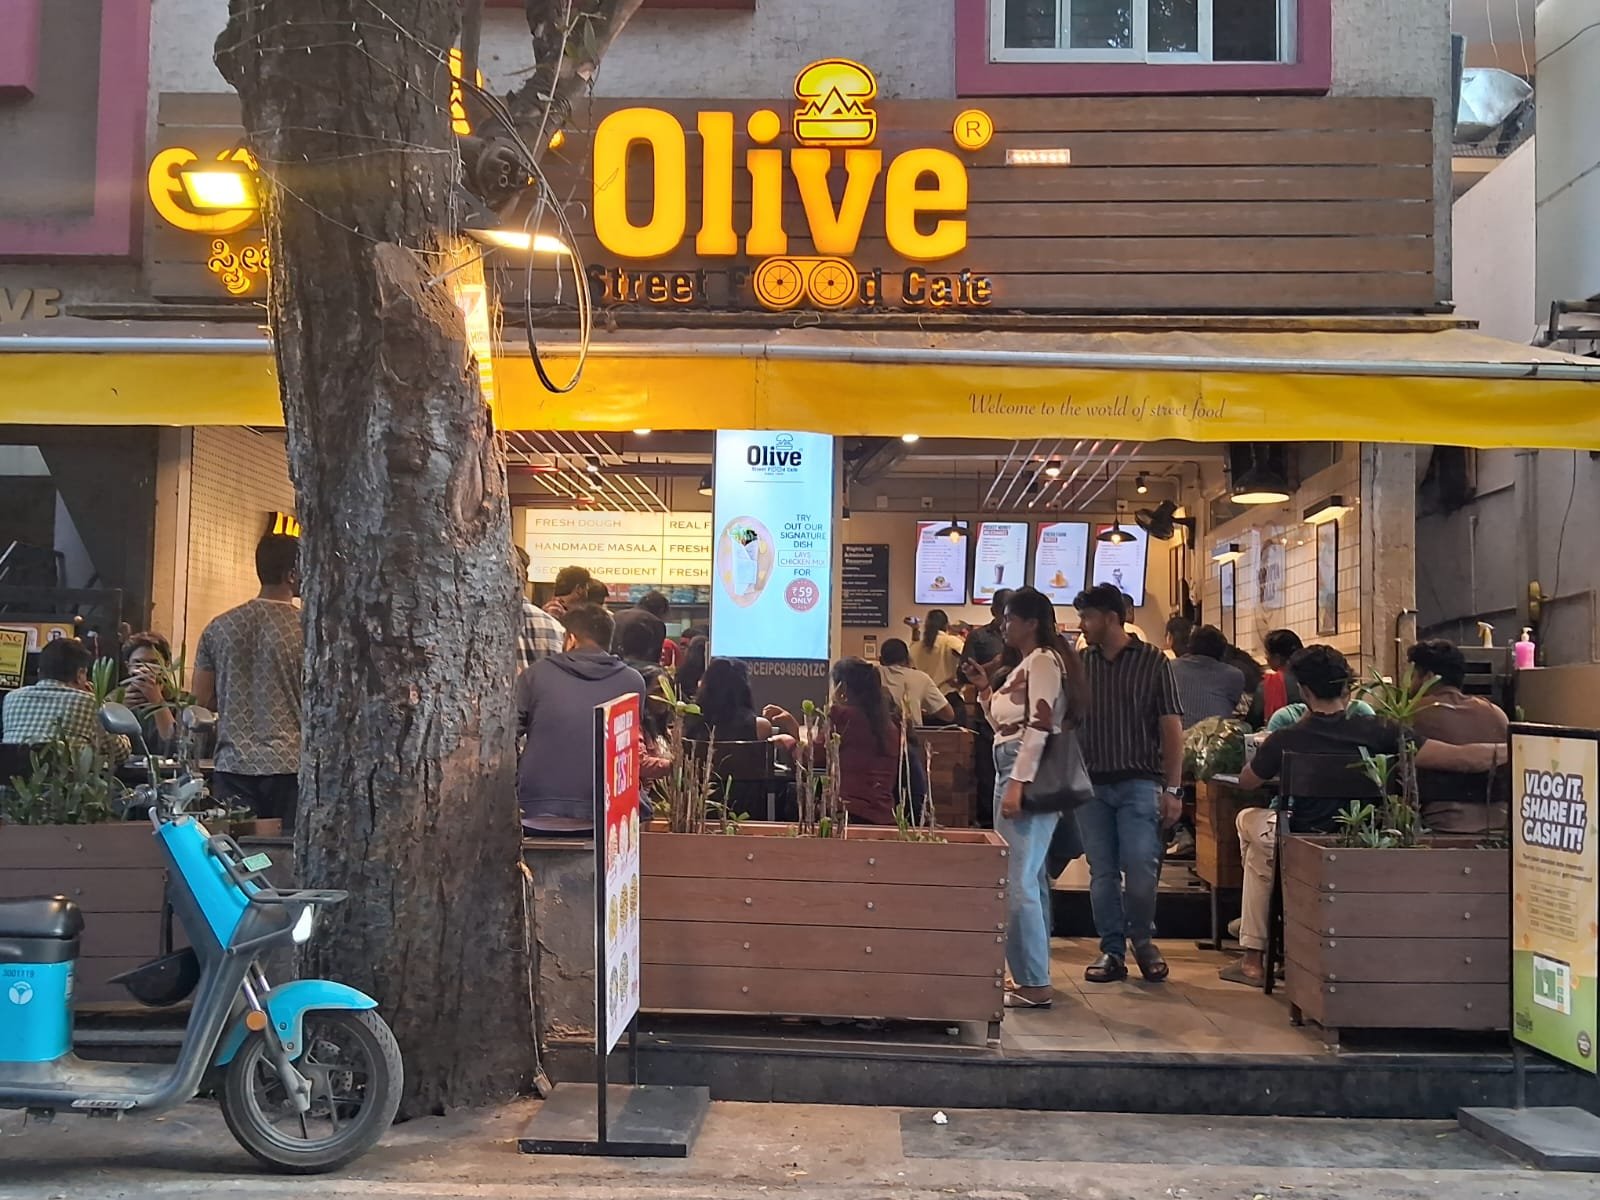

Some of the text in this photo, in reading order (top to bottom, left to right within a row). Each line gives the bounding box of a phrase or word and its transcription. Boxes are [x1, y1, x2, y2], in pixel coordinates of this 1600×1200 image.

[593, 107, 969, 261] Olive
[588, 264, 708, 304] Street
[901, 266, 992, 307] Cafe
[968, 393, 1227, 422] Welcome to the world of street food
[747, 445, 802, 466] Olive
[536, 518, 622, 528] FRESH DOUGH
[796, 514, 812, 522] TRY
[669, 520, 701, 529] REAL
[784, 523, 823, 531] OUT OUR
[780, 531, 826, 540] SIGNATURE
[535, 542, 657, 553] HANDMADE MASALA
[669, 544, 709, 553] FRESH
[793, 540, 813, 549] DISH
[669, 568, 709, 577] FRESH
[793, 568, 811, 577] FOR
[791, 586, 813, 598] ₹59
[790, 597, 813, 605] ONLY
[1525, 772, 1565, 799] VLOG
[1521, 795, 1568, 824] SHARE
[1523, 820, 1584, 851] CASH IT!
